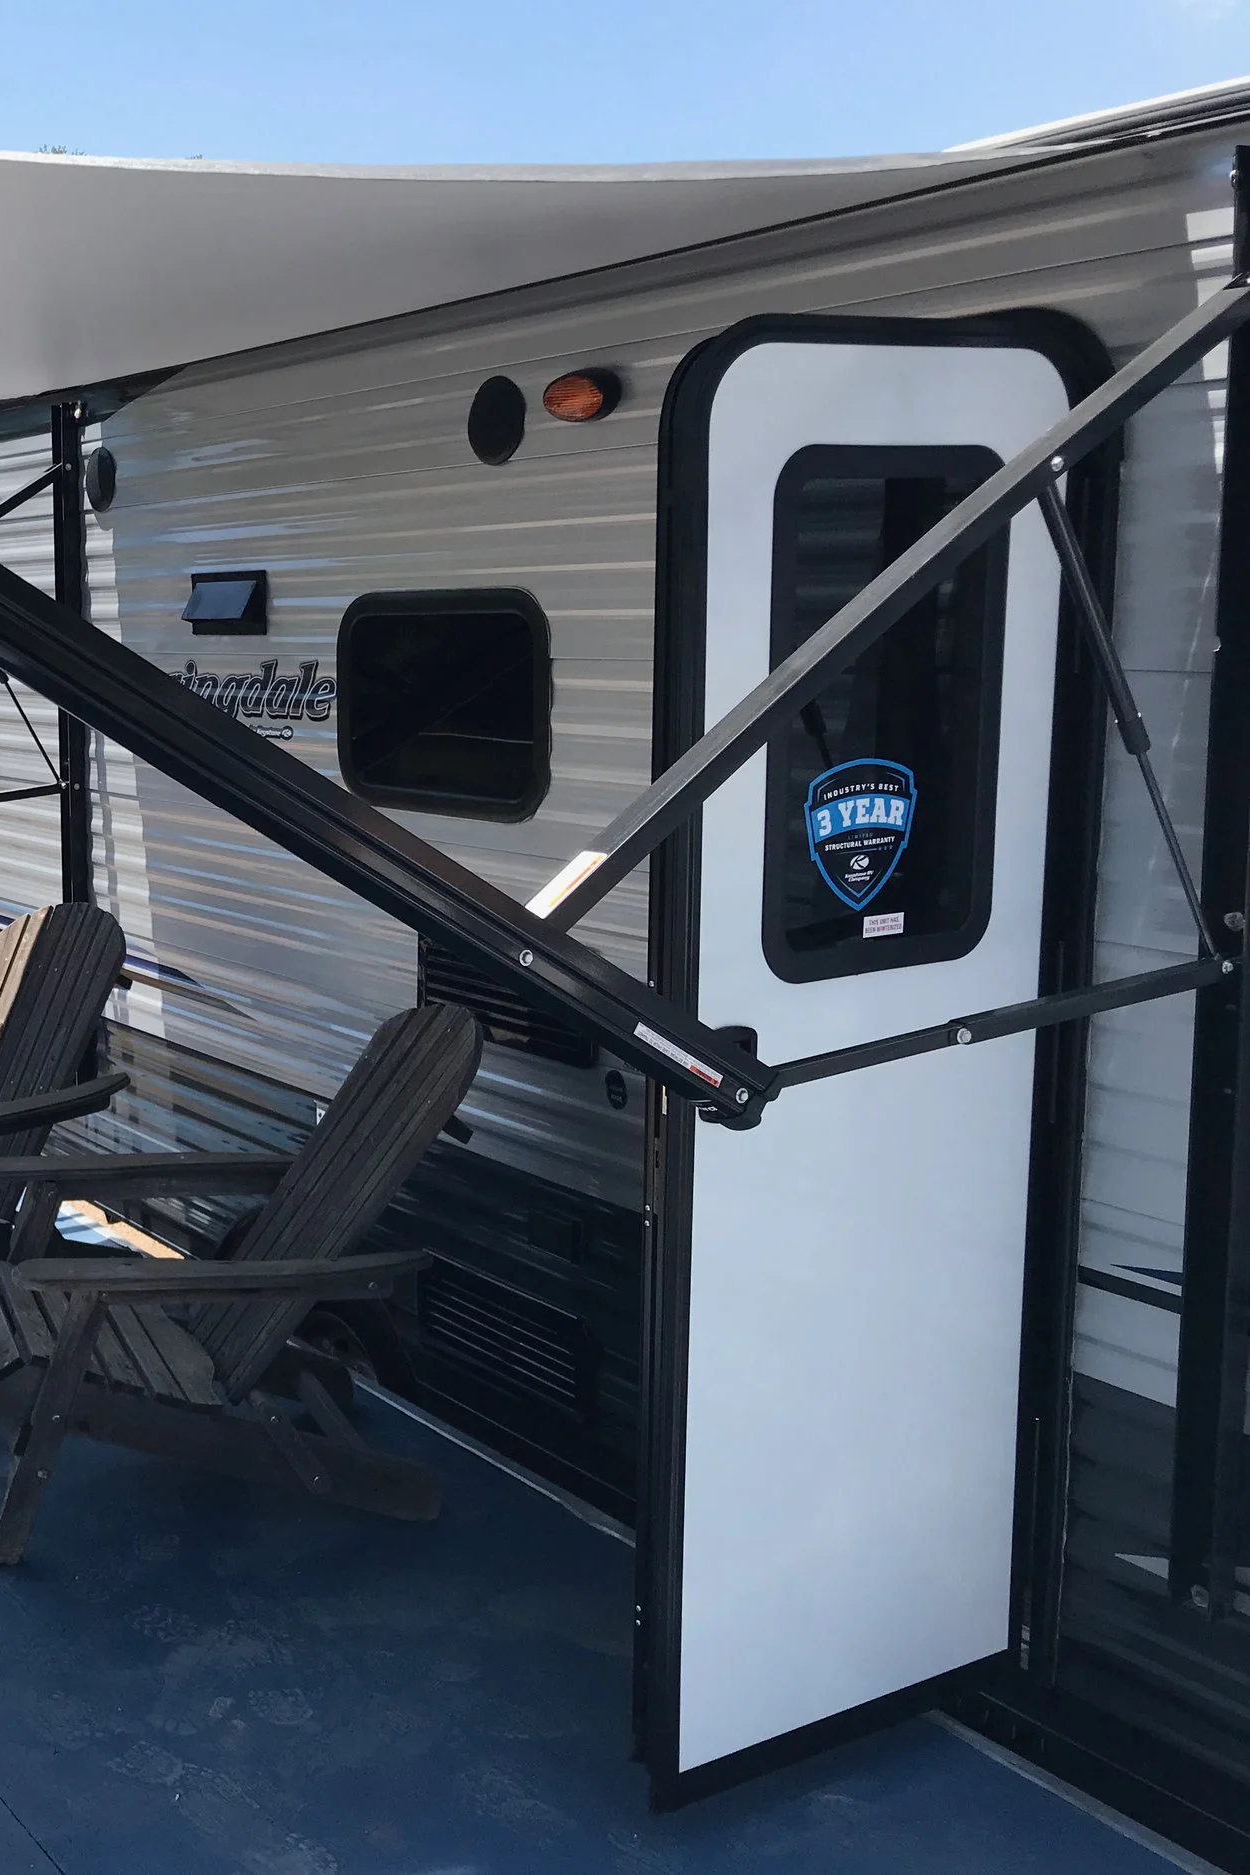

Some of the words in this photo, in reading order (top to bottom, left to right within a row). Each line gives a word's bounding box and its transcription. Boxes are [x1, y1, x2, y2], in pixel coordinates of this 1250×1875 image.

[823, 783, 875, 800] INDUSTRY'S
[878, 783, 899, 792] BEST
[817, 809, 832, 836] 3
[838, 797, 905, 827] YEAR
[824, 840, 862, 851] STRUCTURAL
[863, 835, 895, 847] WARRANTY
